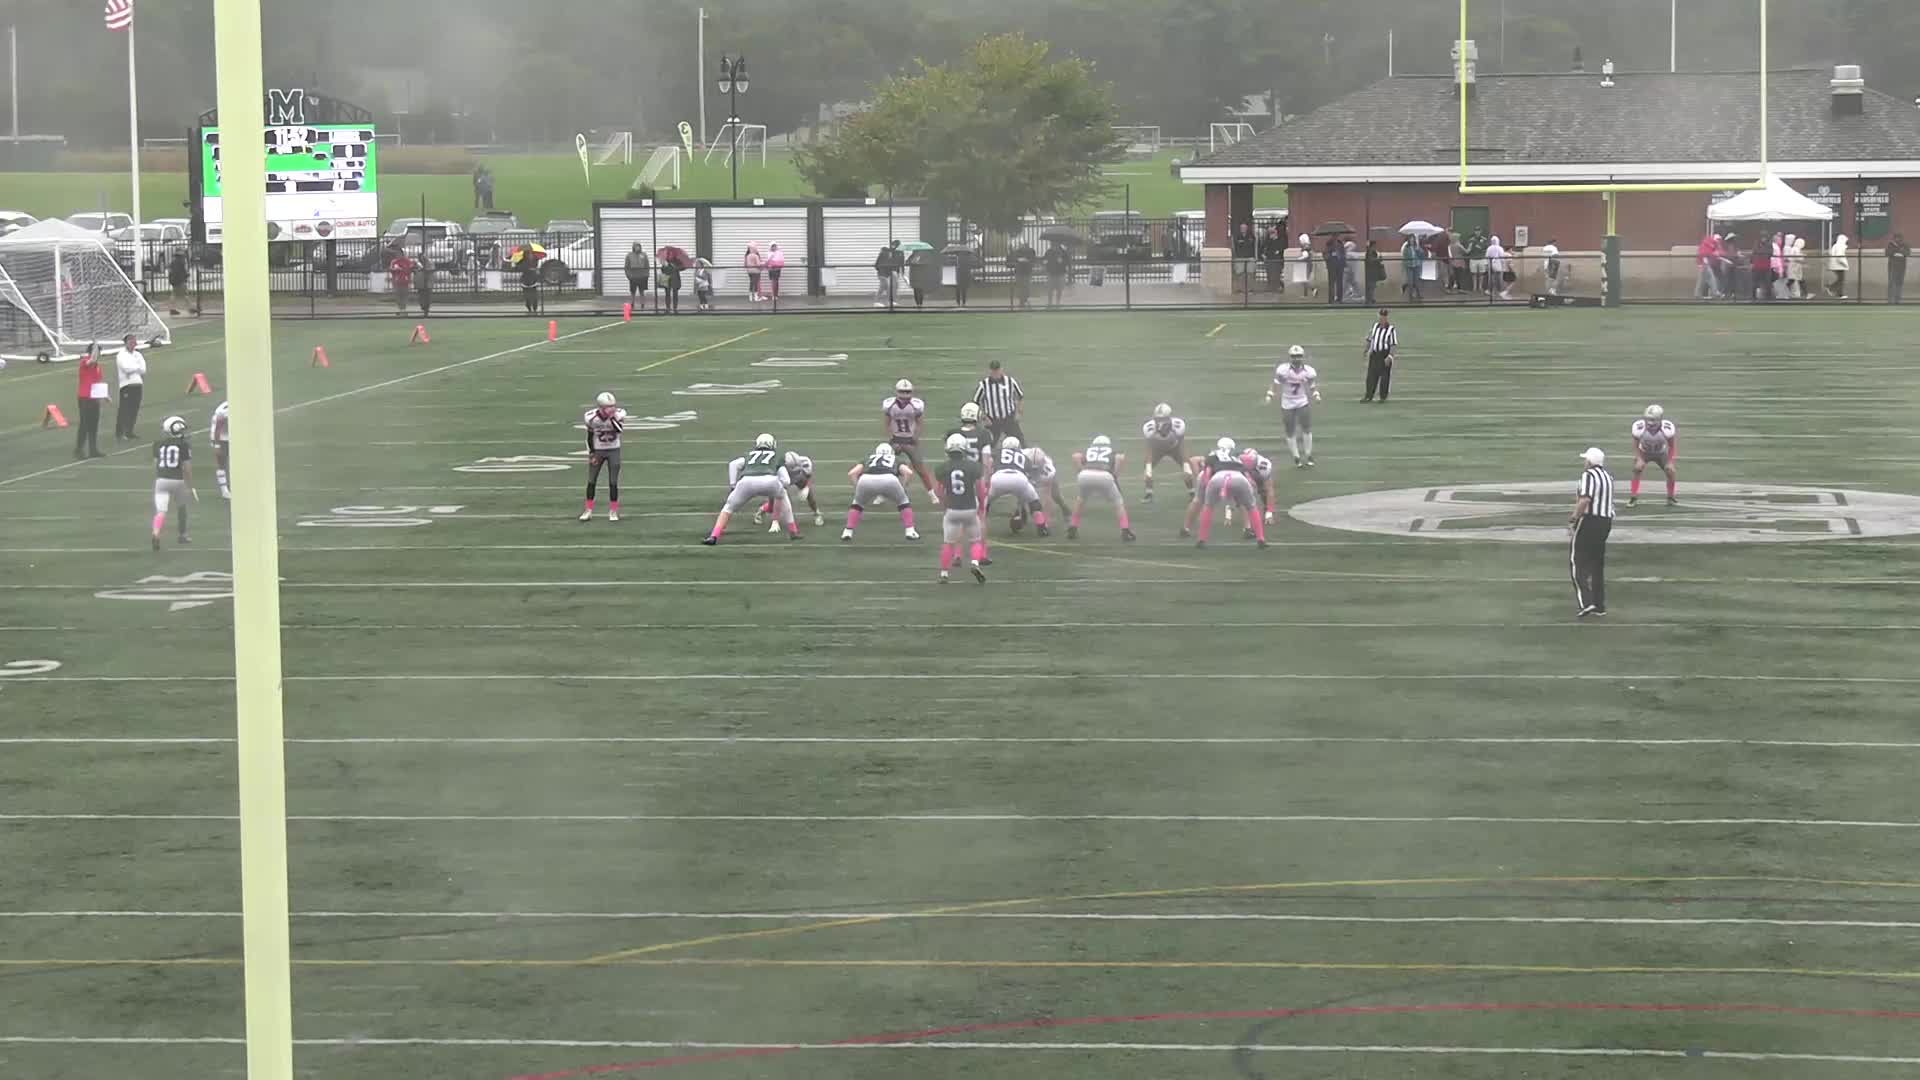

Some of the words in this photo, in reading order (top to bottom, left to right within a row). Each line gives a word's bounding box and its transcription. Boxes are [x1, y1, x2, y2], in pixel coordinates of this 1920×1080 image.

[269, 89, 304, 125] M
[1290, 383, 1300, 395] 7
[895, 419, 911, 433] 11
[159, 445, 180, 468] 10
[747, 450, 775, 465] 77
[868, 454, 896, 468] 79
[1000, 448, 1026, 469] 60
[1086, 446, 1113, 463] 62
[950, 469, 966, 495] 6
